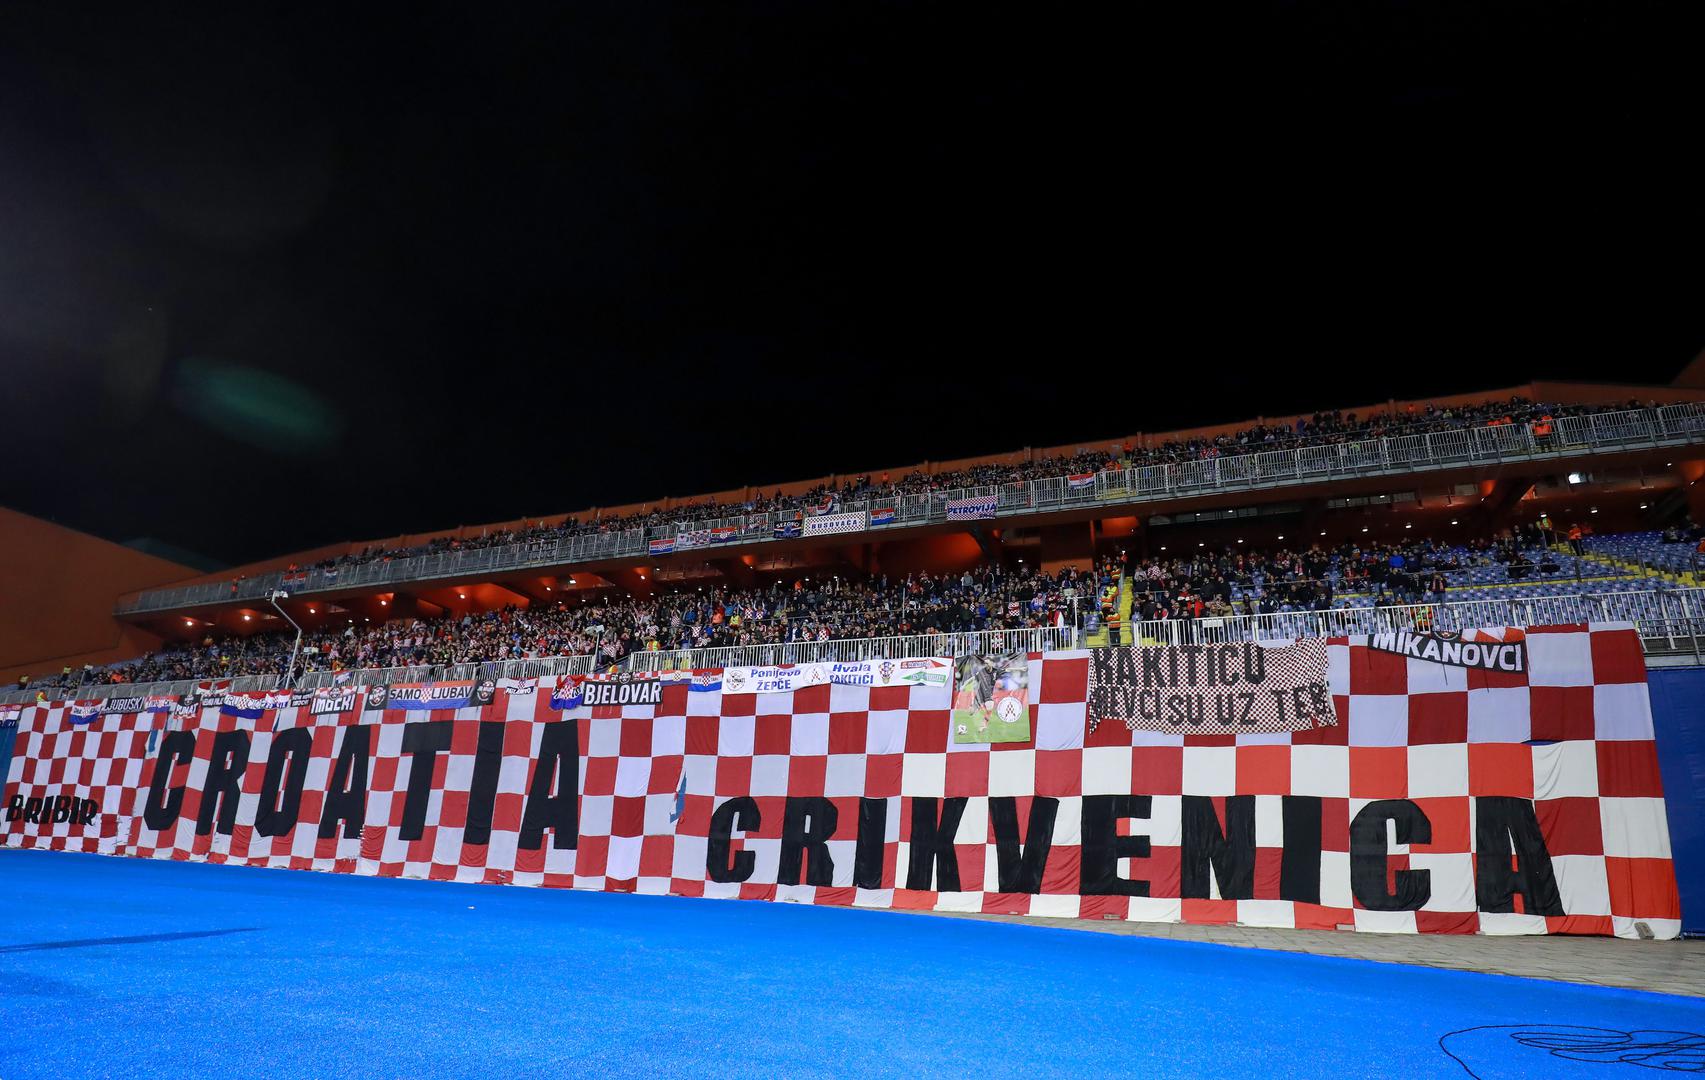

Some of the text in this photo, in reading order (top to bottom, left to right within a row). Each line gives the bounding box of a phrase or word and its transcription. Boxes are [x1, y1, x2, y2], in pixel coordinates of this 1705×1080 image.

[947, 502, 998, 514] PETROVIJA
[1373, 633, 1523, 671] MIKANOVCI
[833, 663, 872, 673] Hvala
[390, 689, 421, 700] SAMO
[431, 686, 473, 699] LJUBAV
[584, 683, 662, 705] BJELOVAR
[757, 678, 792, 691] ŽEPČE
[1168, 694, 1204, 727] SU
[1217, 692, 1258, 726] UZ
[143, 720, 579, 850] CROATIA
[5, 794, 99, 827] BRIBIR
[706, 795, 1566, 917] CRIKVENICA
